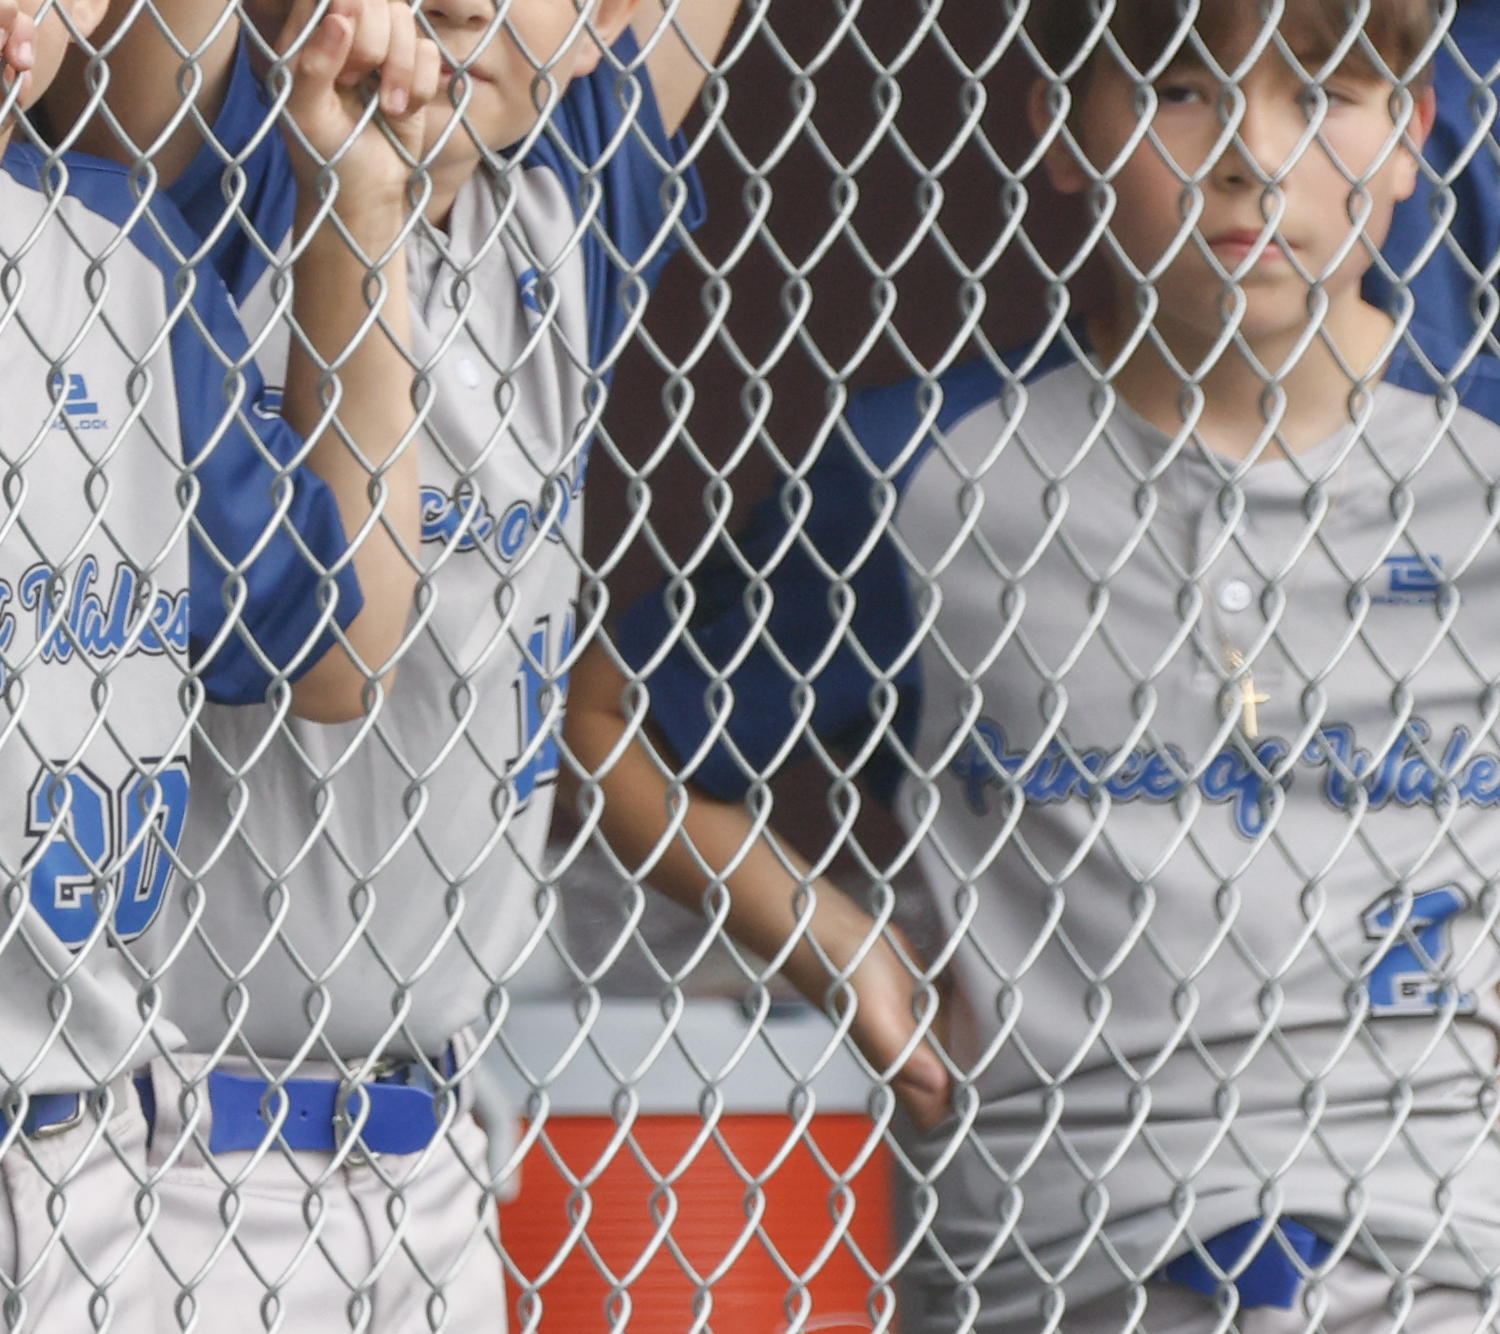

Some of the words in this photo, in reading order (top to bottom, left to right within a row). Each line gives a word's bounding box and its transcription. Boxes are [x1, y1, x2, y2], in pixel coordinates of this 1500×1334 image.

[19, 554, 190, 665] Wales
[951, 717, 1190, 816] Prince
[1197, 736, 1296, 839] of
[22, 753, 191, 956] 20
